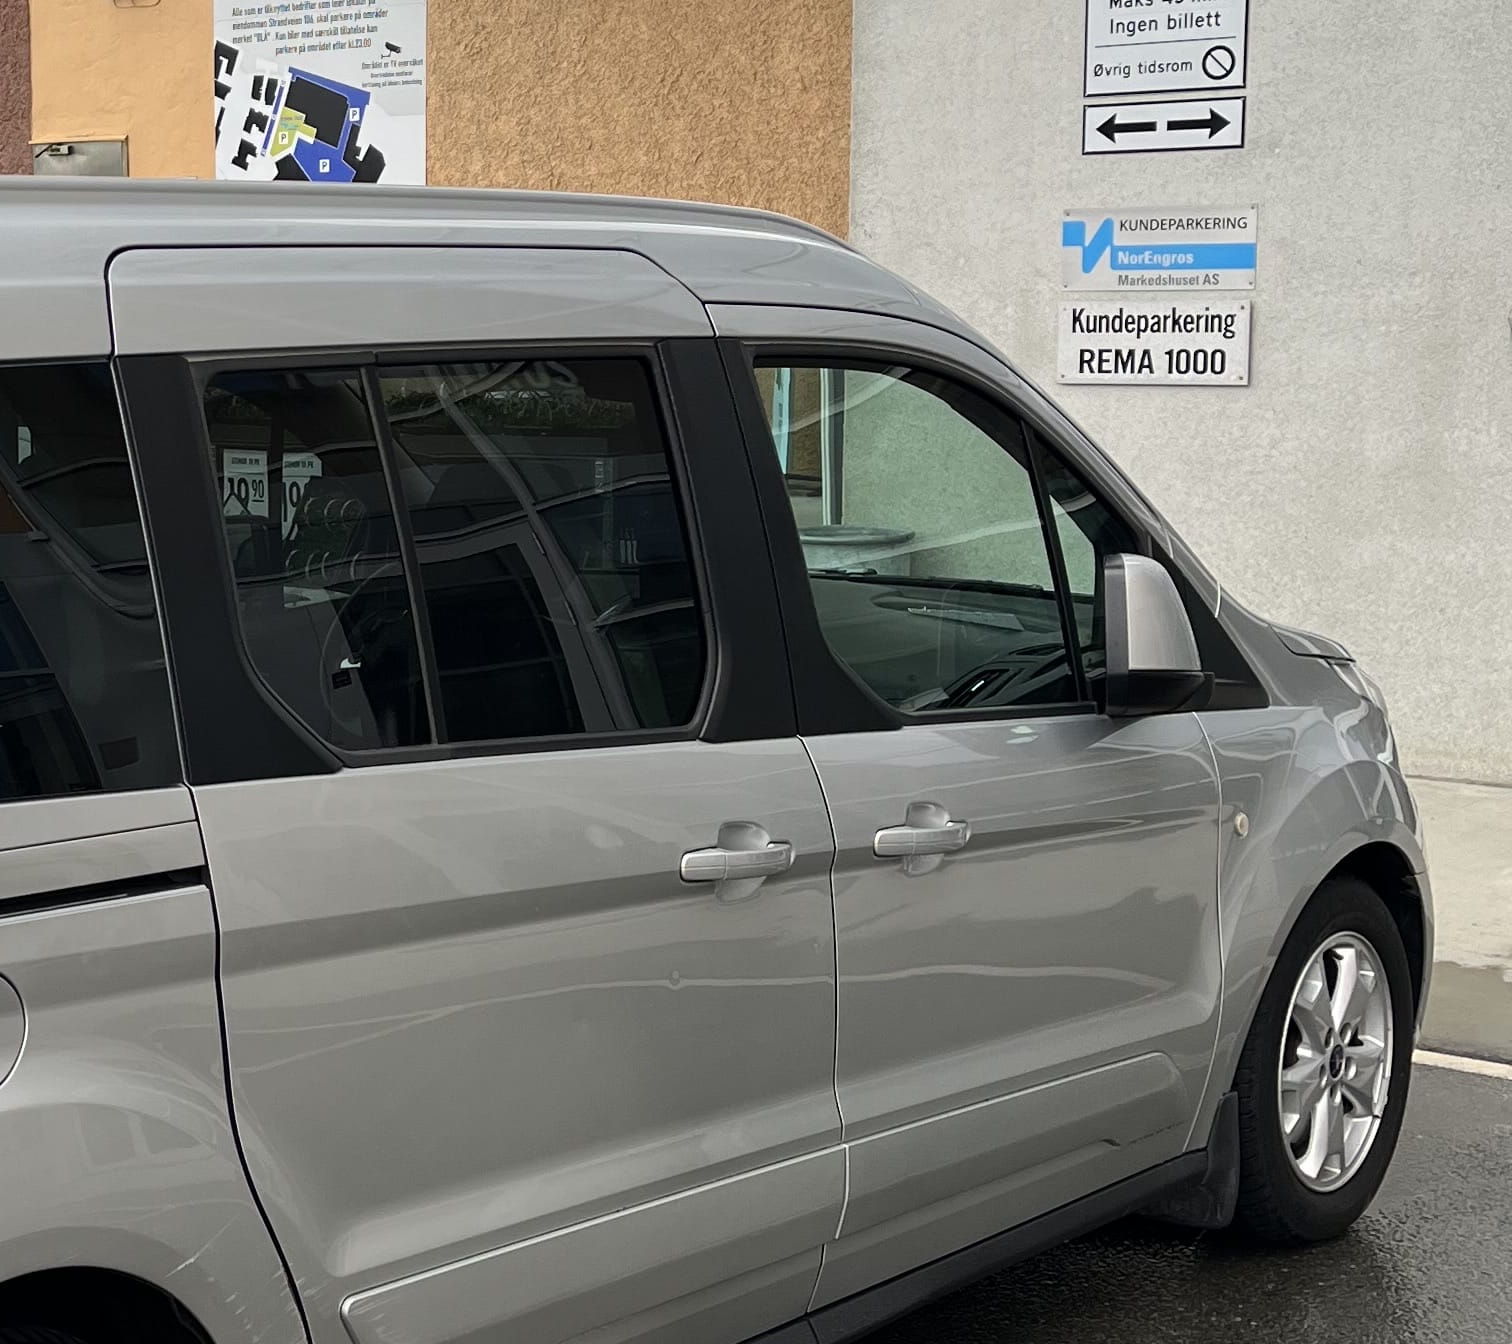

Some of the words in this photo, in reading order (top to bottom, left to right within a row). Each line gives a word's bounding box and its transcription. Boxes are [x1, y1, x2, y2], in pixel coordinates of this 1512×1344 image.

[1109, 17, 1159, 37] Ingen
[1167, 11, 1221, 31] billett
[1093, 63, 1132, 80] Øvrig
[1138, 58, 1193, 75] tidsrom
[1119, 216, 1248, 232] KUNDEPARKERING
[1117, 251, 1194, 267] NorEngros
[1117, 274, 1200, 287] Markedshuset
[1202, 273, 1220, 286] AS
[1071, 307, 1237, 339] Kundeparkering
[1078, 348, 1155, 375] REMA
[1164, 347, 1227, 375] 1000
